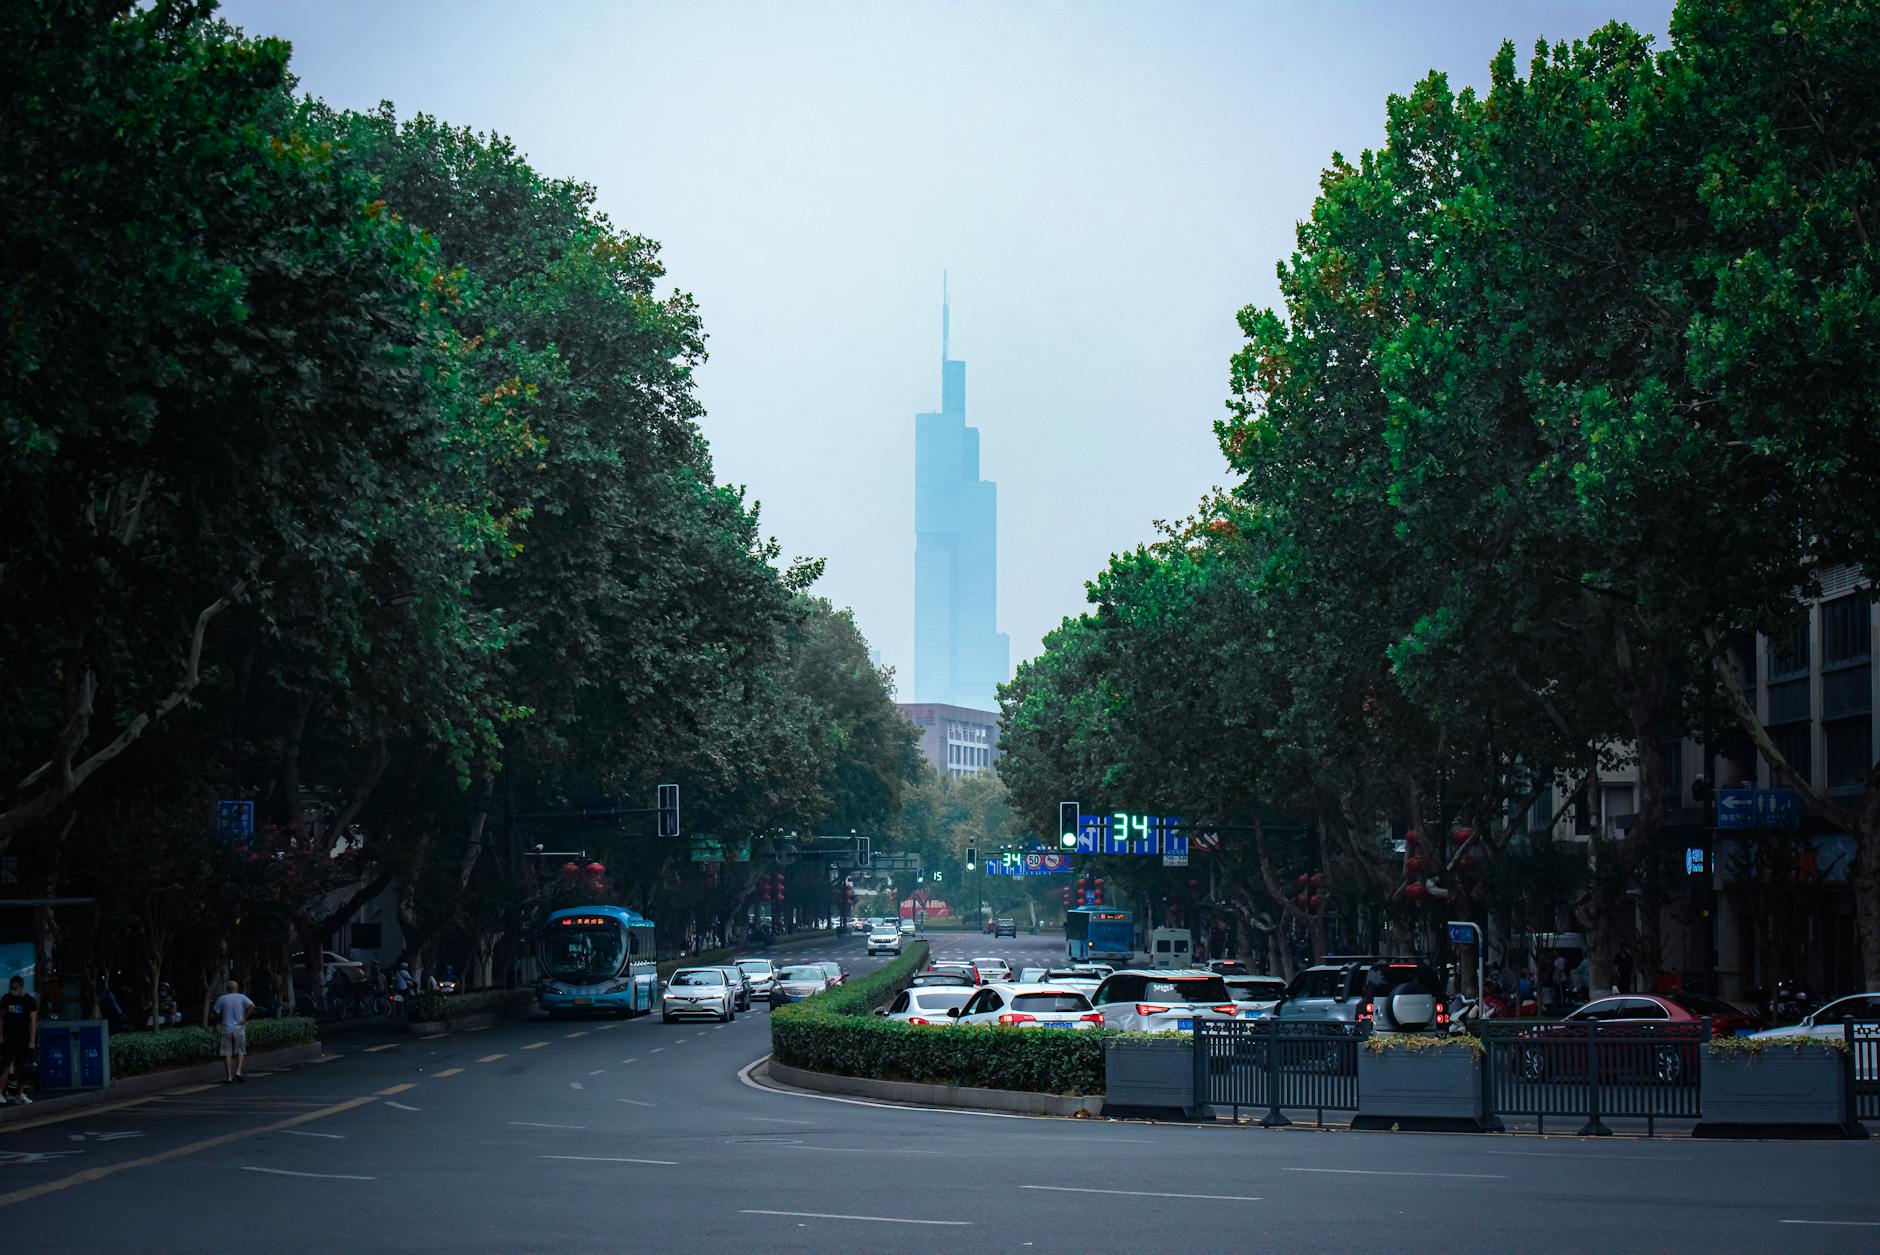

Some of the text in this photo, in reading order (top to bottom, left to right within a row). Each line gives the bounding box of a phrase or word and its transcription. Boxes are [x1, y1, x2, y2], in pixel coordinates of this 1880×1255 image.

[1113, 813, 1148, 840] 34
[1003, 853, 1021, 866] 34
[1029, 855, 1039, 865] 50
[933, 872, 942, 881] 15
